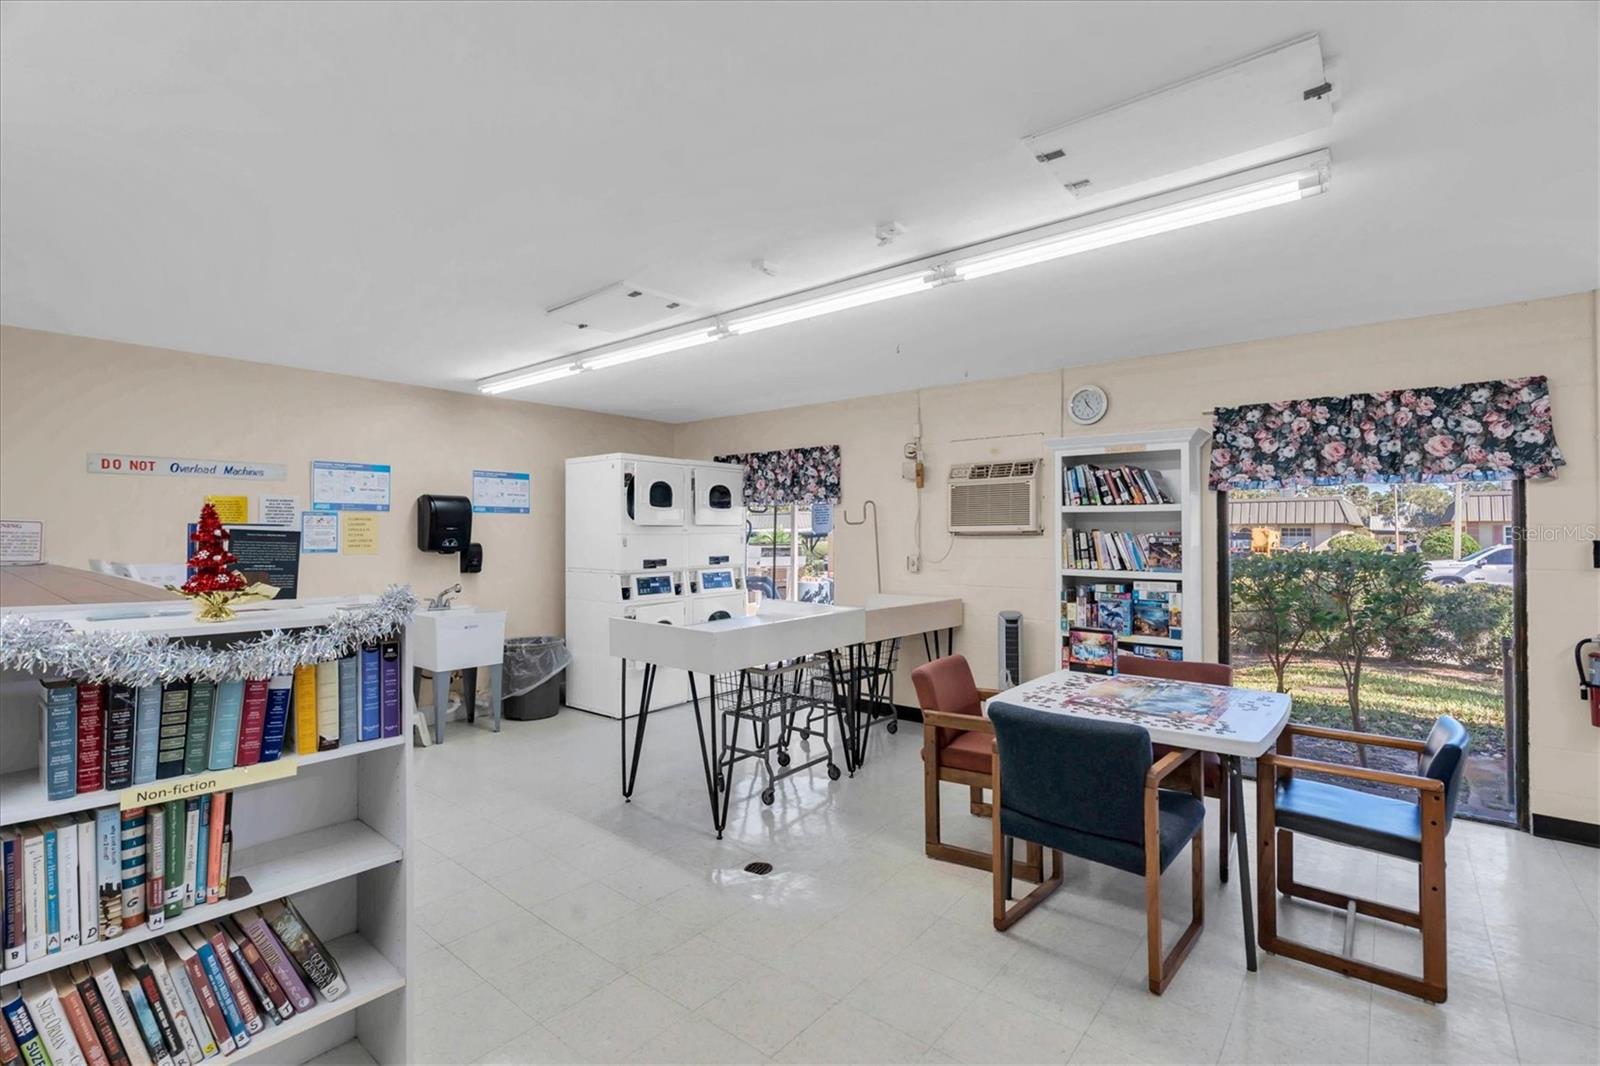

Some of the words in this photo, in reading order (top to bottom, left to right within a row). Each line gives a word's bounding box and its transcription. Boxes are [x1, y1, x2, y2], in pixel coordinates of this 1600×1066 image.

[101, 458, 122, 470] DO
[129, 460, 156, 472] NOT
[170, 462, 217, 475] Overload
[223, 465, 265, 477] Machines
[136, 780, 216, 802] Non-fiction
[15, 1005, 34, 1034] WOMEN
[36, 997, 57, 1023] SUZE
[44, 1017, 67, 1050] ORMAN
